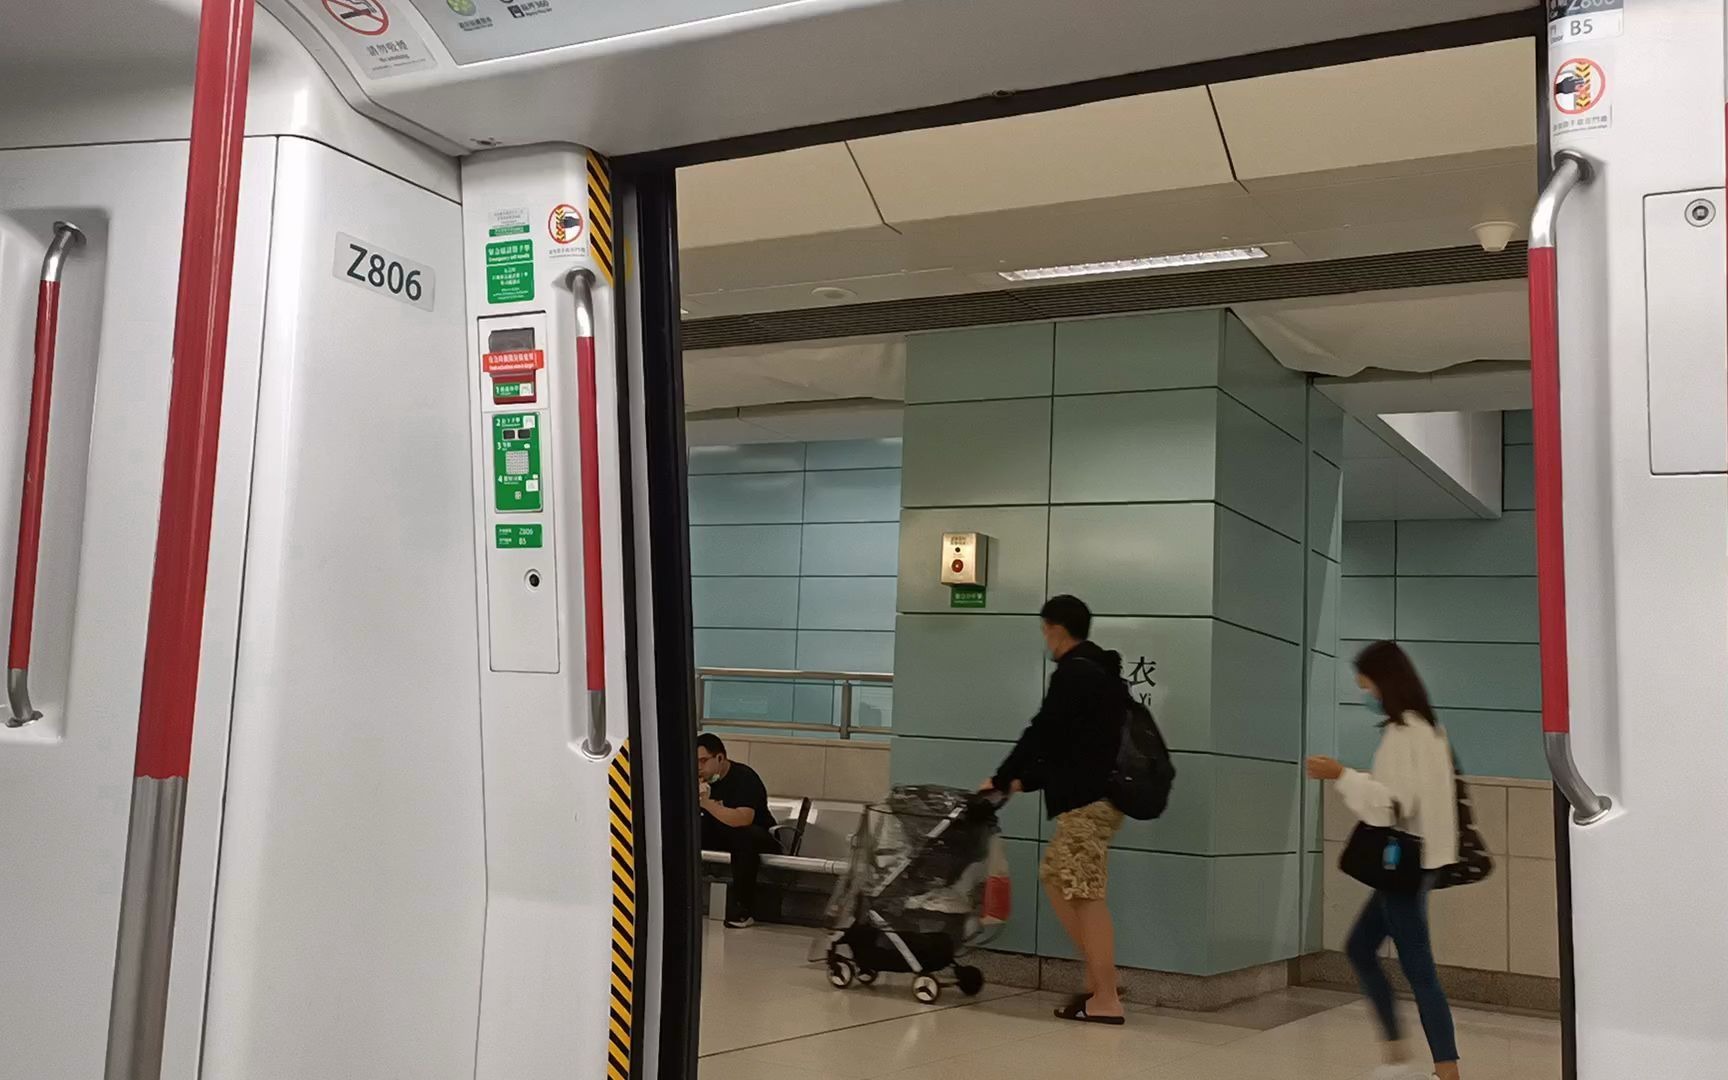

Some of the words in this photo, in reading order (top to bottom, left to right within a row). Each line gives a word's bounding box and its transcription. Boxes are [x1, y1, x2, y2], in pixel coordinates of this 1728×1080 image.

[1570, 19, 1593, 36] B5
[346, 243, 422, 301] Z806
[1119, 656, 1156, 687] 衣
